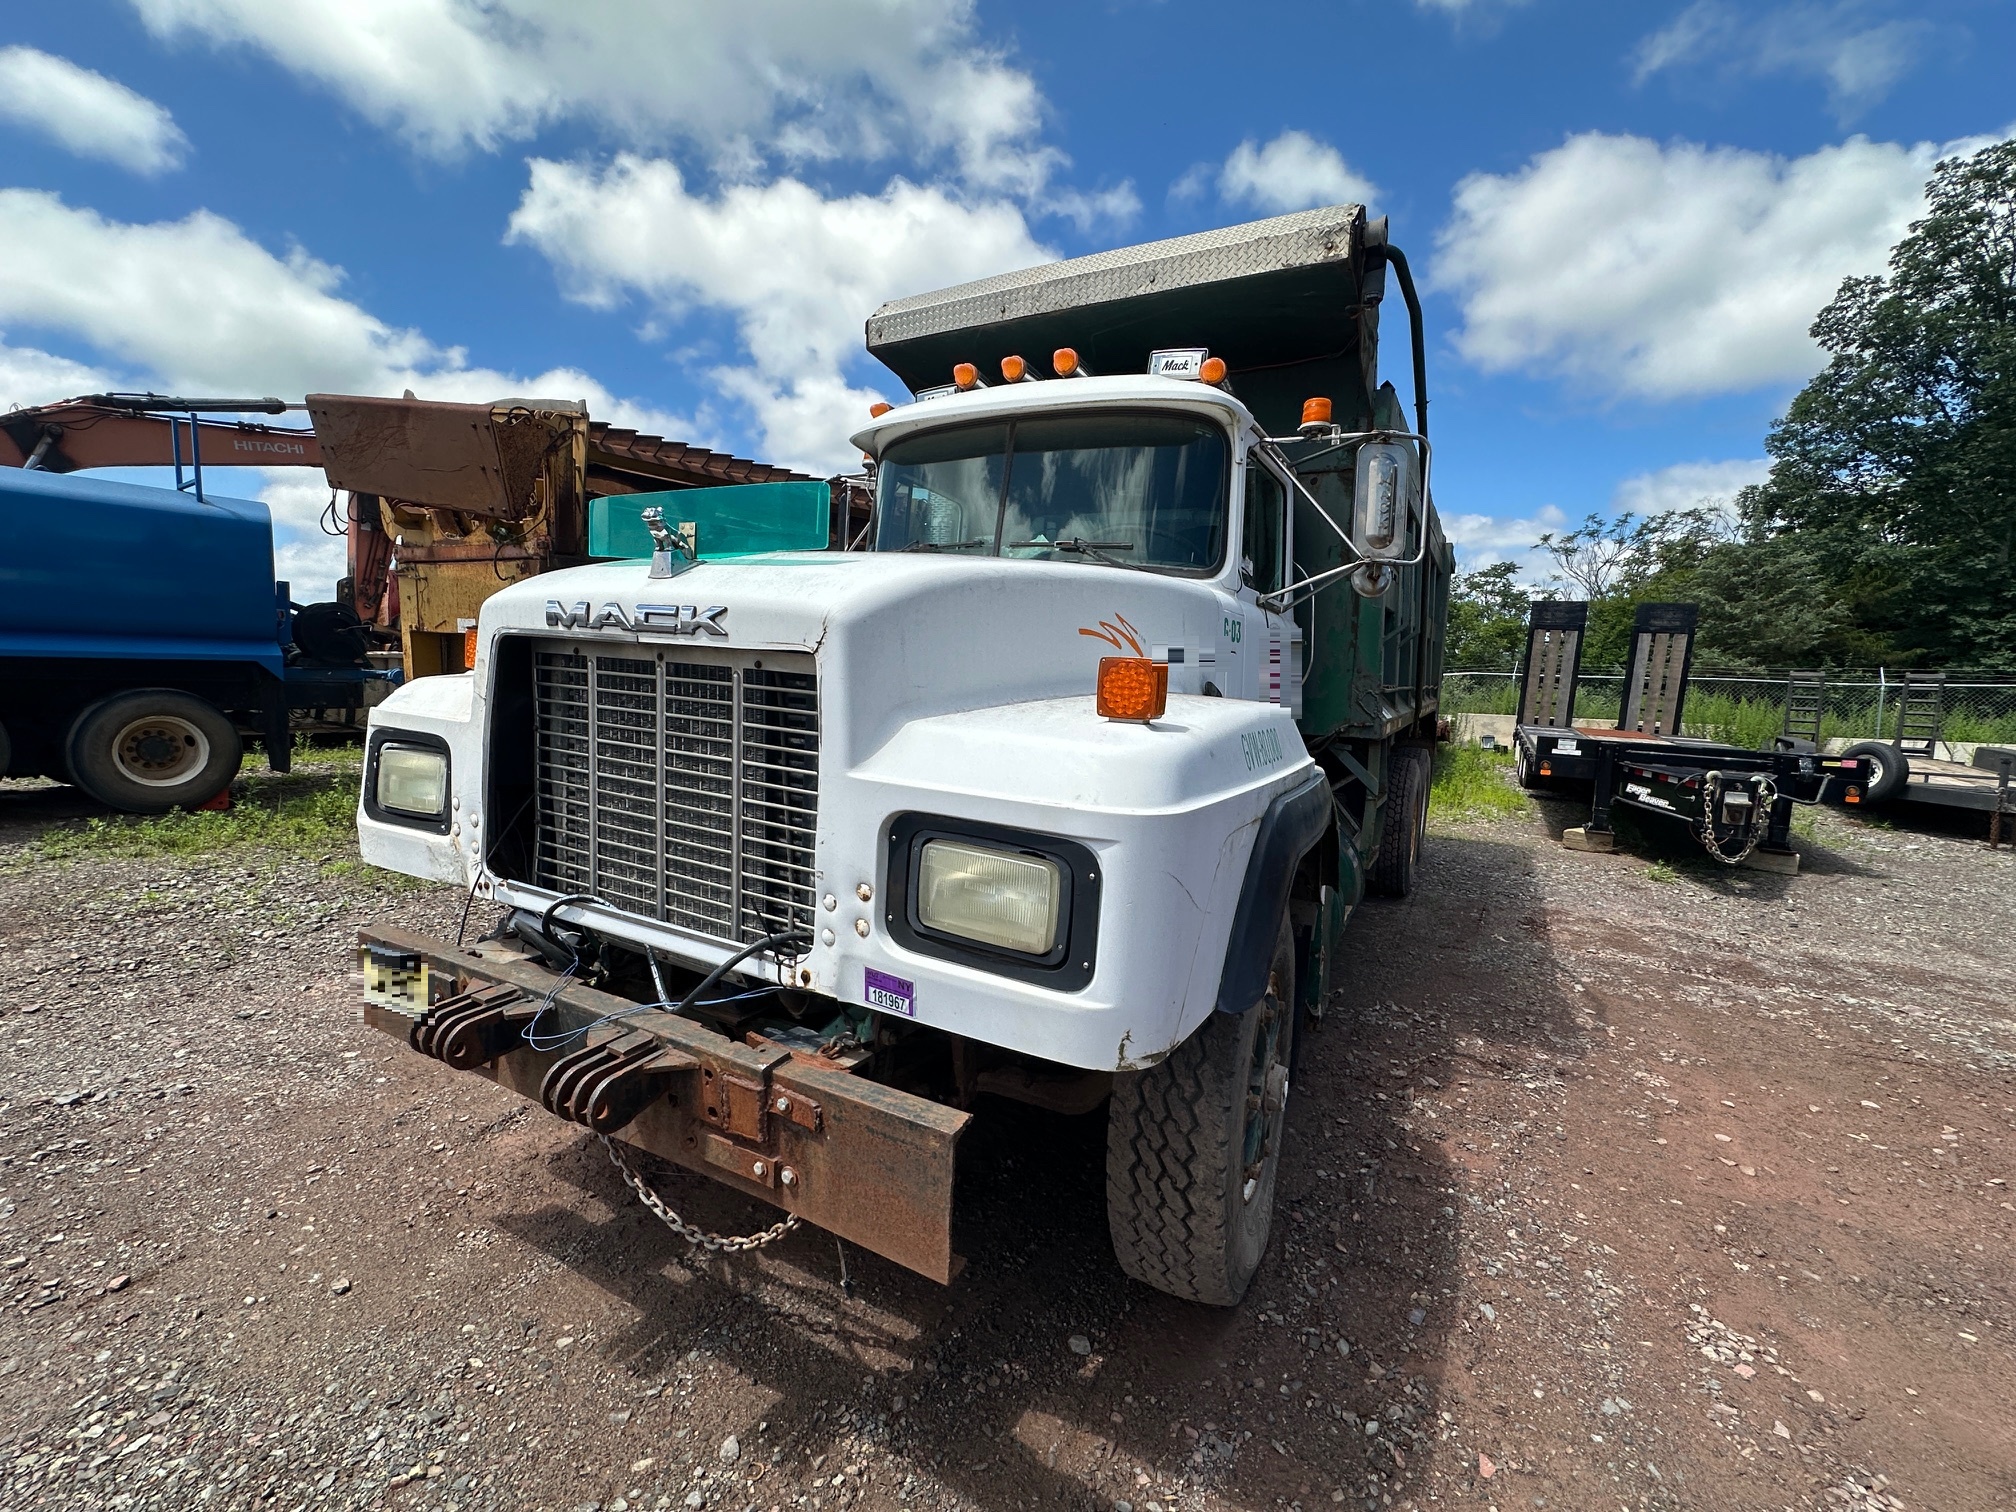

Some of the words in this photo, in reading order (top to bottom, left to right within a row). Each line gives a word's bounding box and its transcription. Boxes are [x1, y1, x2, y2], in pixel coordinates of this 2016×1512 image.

[1162, 359, 1189, 371] Mack
[233, 440, 304, 454] HITACHI
[546, 599, 728, 636] MACK
[898, 979, 911, 991] NY
[872, 988, 905, 1010] 181967
